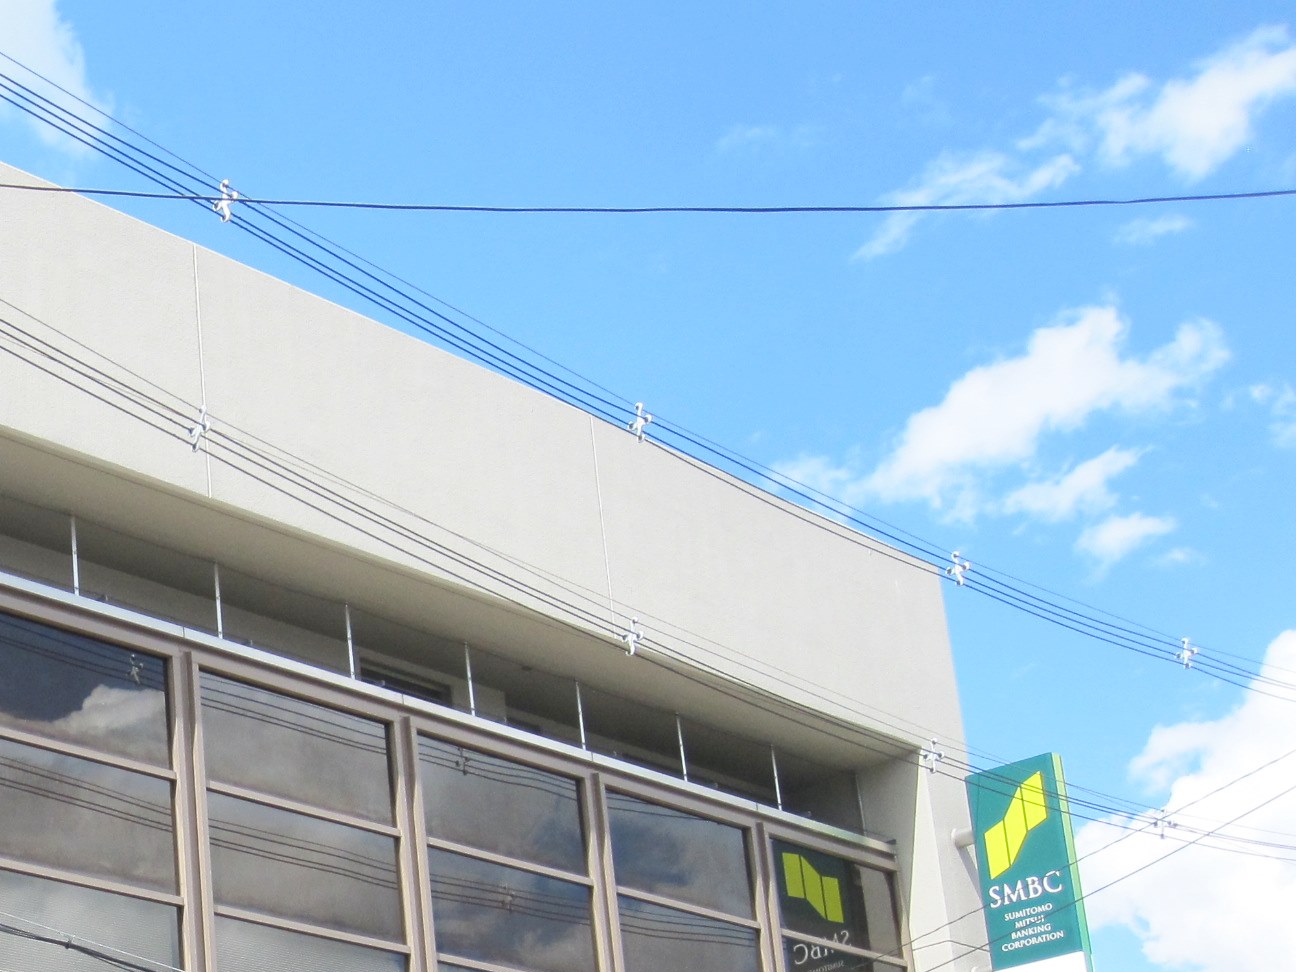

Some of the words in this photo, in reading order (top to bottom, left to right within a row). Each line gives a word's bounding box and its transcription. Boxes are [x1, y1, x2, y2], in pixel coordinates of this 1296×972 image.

[989, 870, 1062, 908] SMBC
[1004, 902, 1053, 921] SUMITOMO
[1015, 914, 1045, 929] MITSUI
[1001, 930, 1065, 952] CORPORATION
[1011, 923, 1052, 940] BANKING
